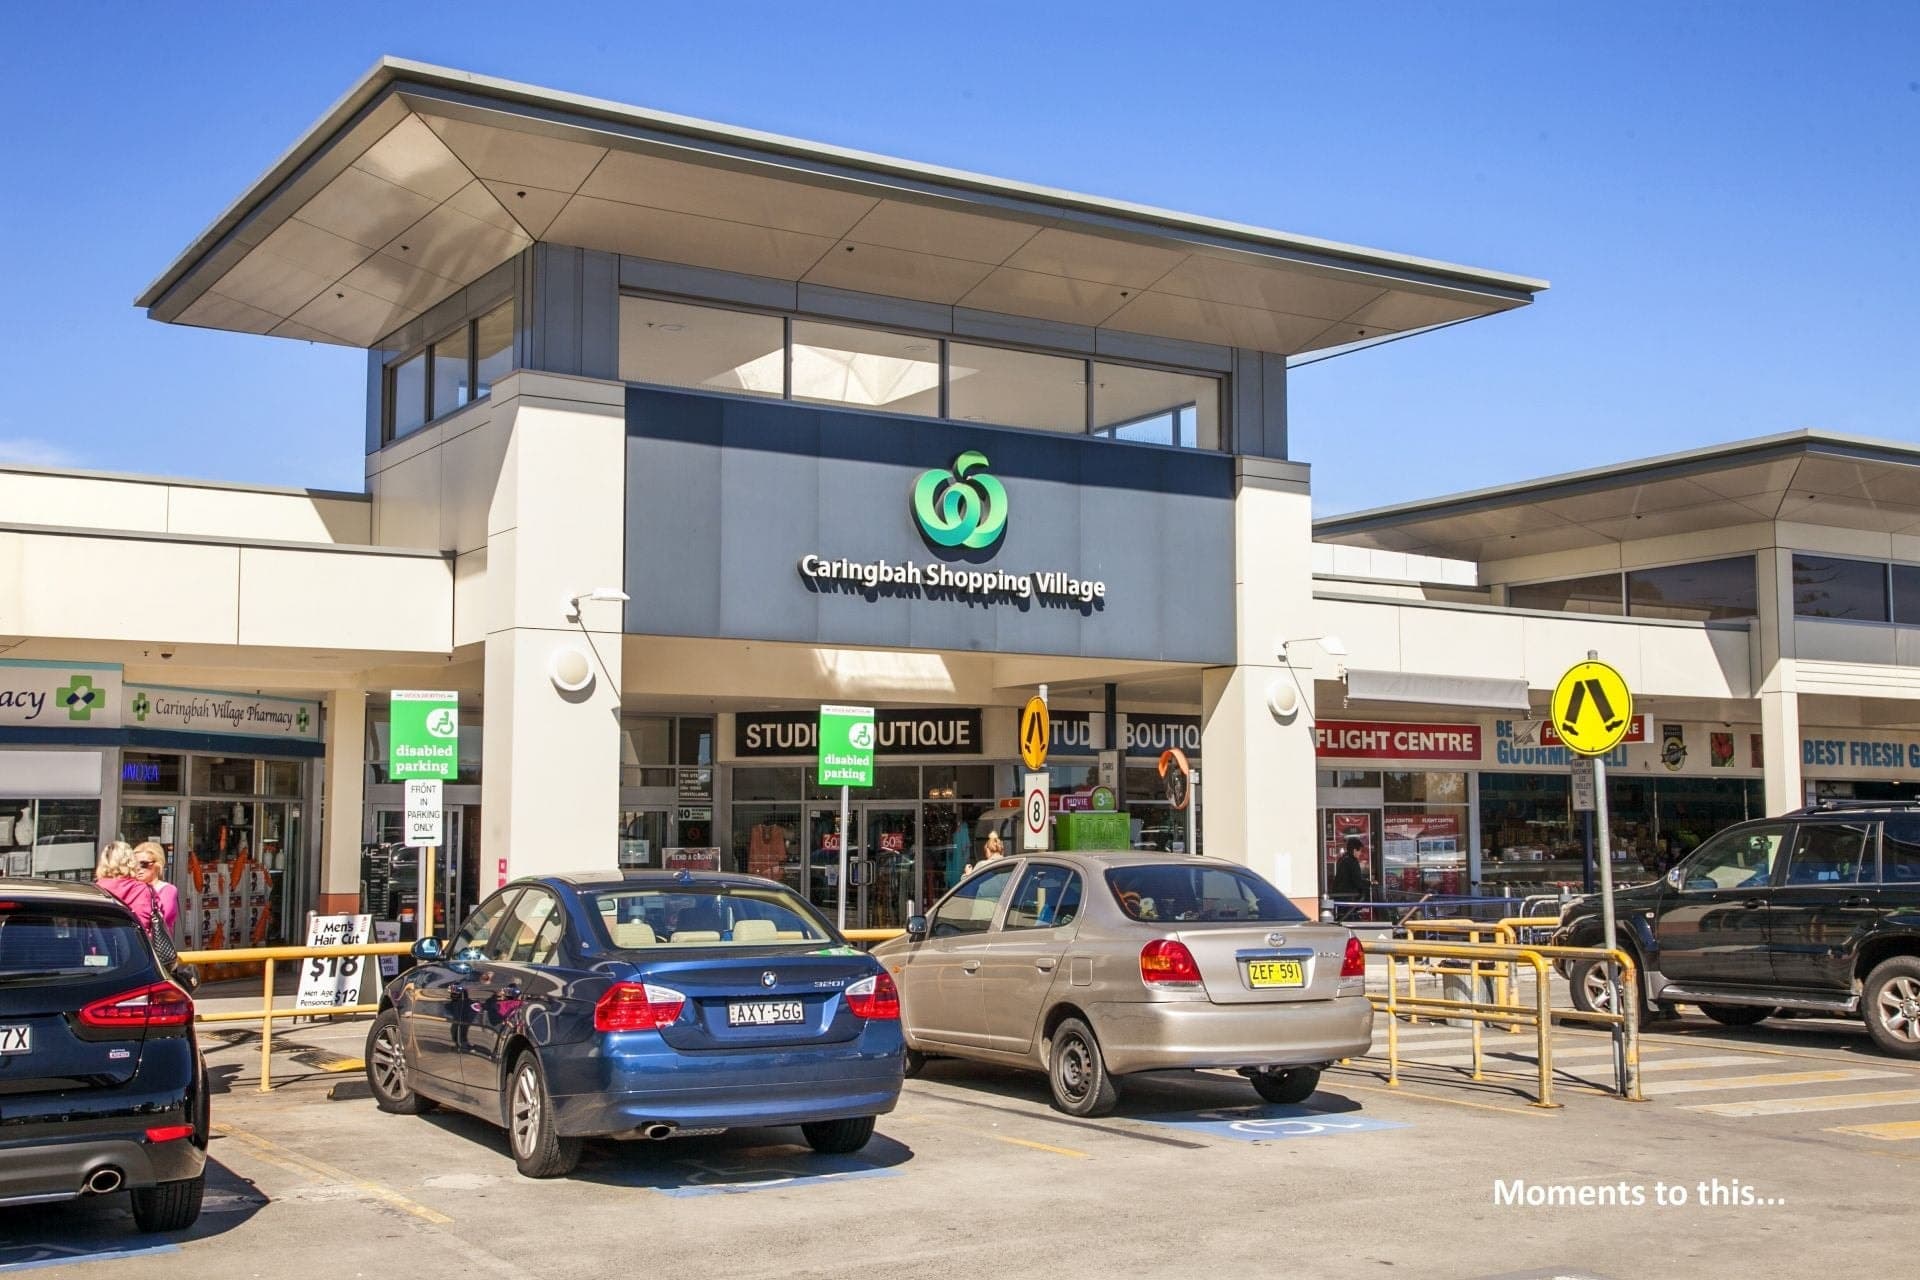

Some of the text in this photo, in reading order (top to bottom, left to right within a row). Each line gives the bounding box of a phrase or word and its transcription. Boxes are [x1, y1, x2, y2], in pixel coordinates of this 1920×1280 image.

[801, 555, 1106, 602] Caringbah Shopping Village
[156, 698, 293, 731] Caringbah Village Pharmacy
[746, 720, 971, 749] STUDI UTIQUE
[1050, 721, 1200, 749] TUD BOUTIQ
[1496, 720, 1512, 738] BE
[1316, 728, 1474, 752] FLIGHT CENTRE
[396, 744, 453, 757] disabled
[1497, 739, 1628, 767] GOURME ELI
[1803, 740, 1847, 766] BEST
[1850, 741, 1904, 767] FRESH
[395, 759, 449, 775] parking
[824, 753, 870, 766] disabled
[823, 767, 866, 783] parking
[411, 785, 437, 794] FRONT
[420, 798, 428, 806] IN
[407, 811, 440, 819] PARKING
[678, 809, 691, 819] NO
[1033, 801, 1041, 823] 8
[413, 823, 434, 832] ONLY
[323, 921, 355, 934] Men's
[314, 933, 361, 946] Hair Cut
[309, 955, 359, 982] $18
[300, 999, 334, 1007] Pensioners
[320, 989, 334, 998] Age
[335, 988, 358, 1004] $12
[0, 1027, 28, 1050] 7X
